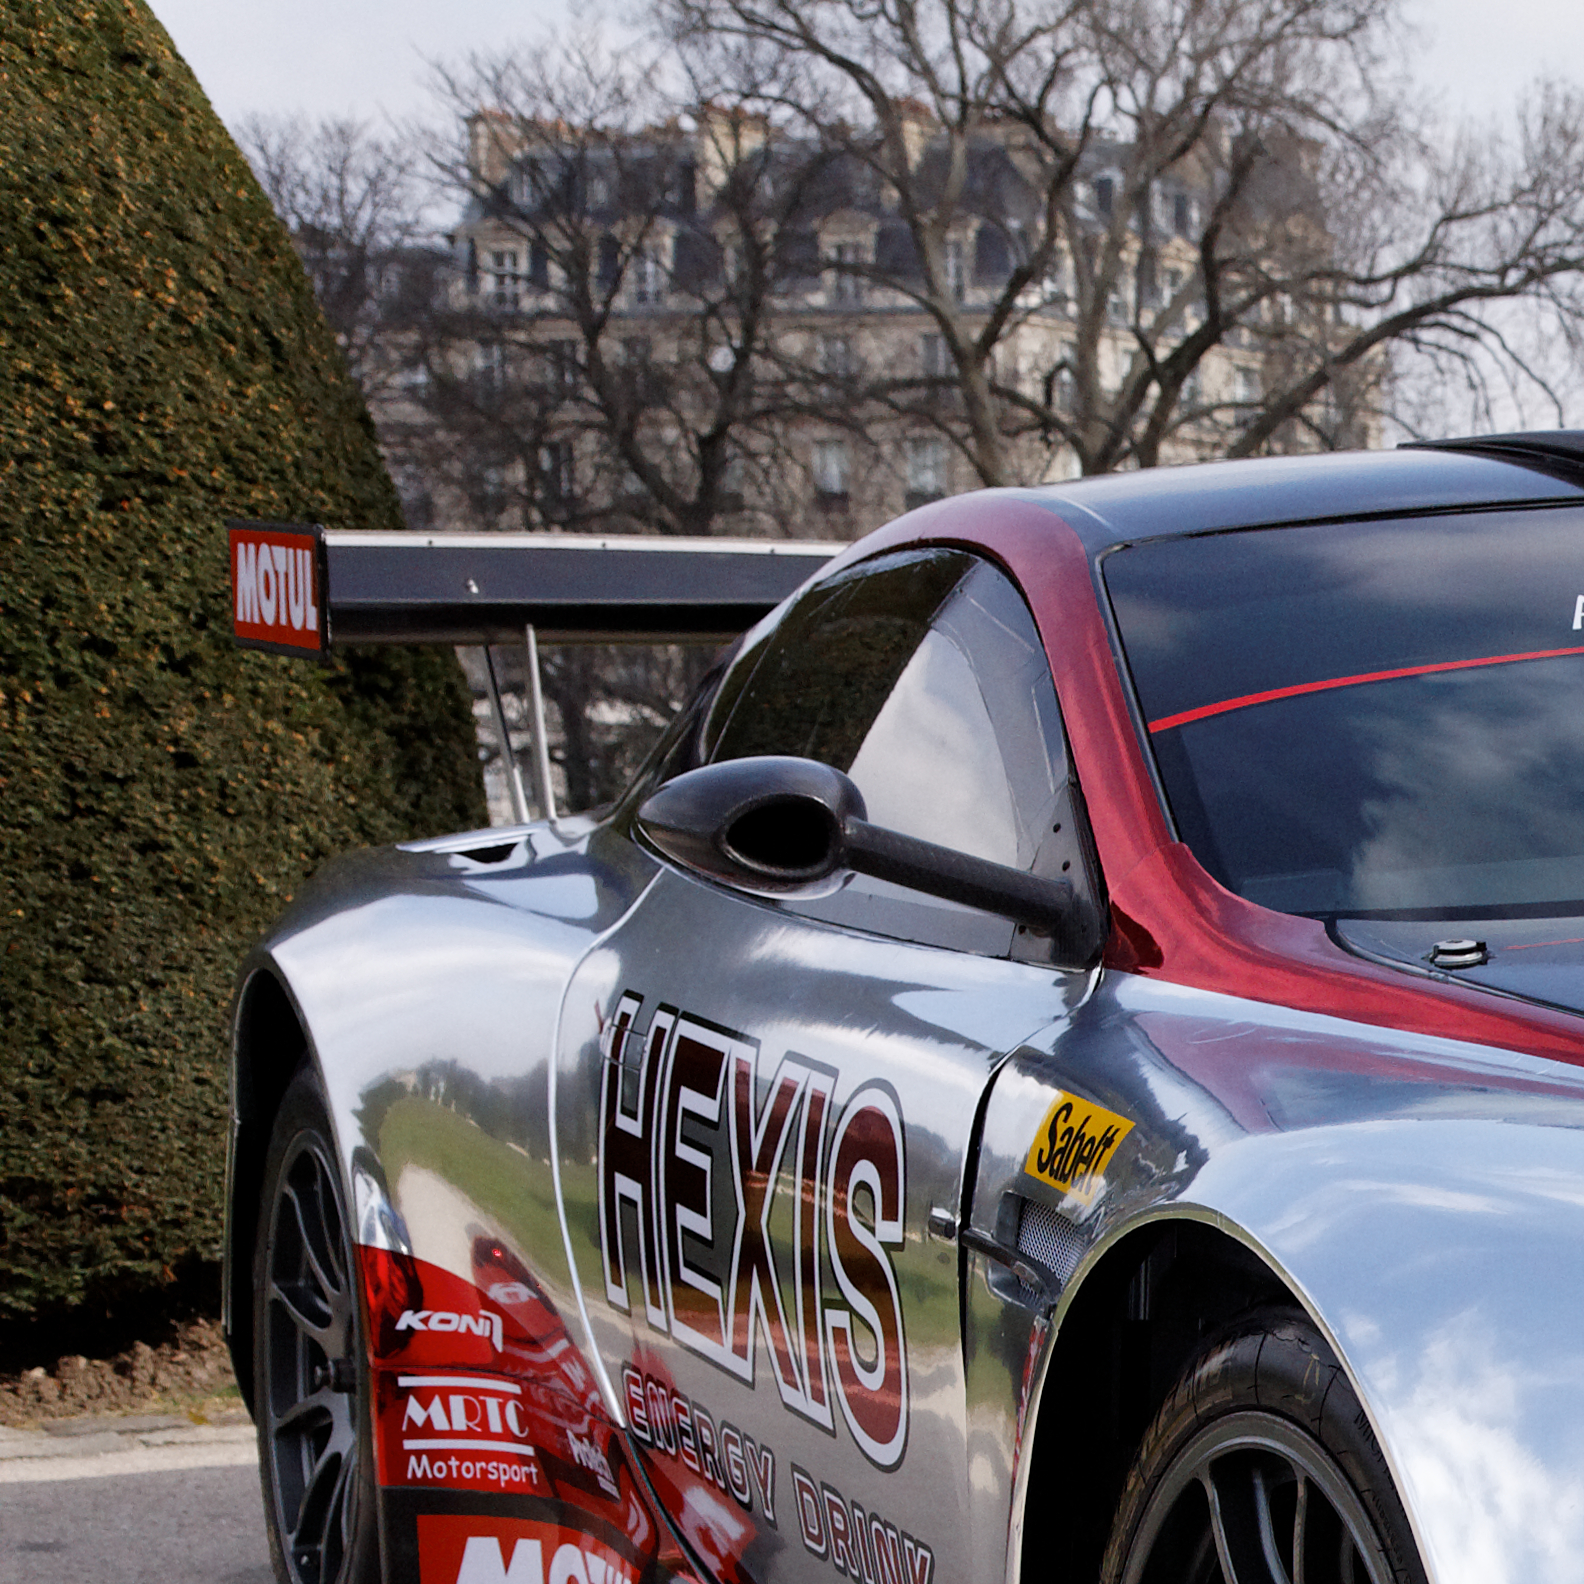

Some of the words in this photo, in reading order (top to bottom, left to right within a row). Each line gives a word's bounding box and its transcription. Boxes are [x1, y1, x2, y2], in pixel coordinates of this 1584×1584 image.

[237, 542, 318, 631] MOTUL
[1036, 1101, 1121, 1195] Sabelt
[600, 989, 910, 1474] HEXIS
[394, 1309, 497, 1342] KONI
[402, 1394, 530, 1438] MRTC
[622, 1360, 778, 1530] ENERGY
[406, 1454, 539, 1488] Motorsport
